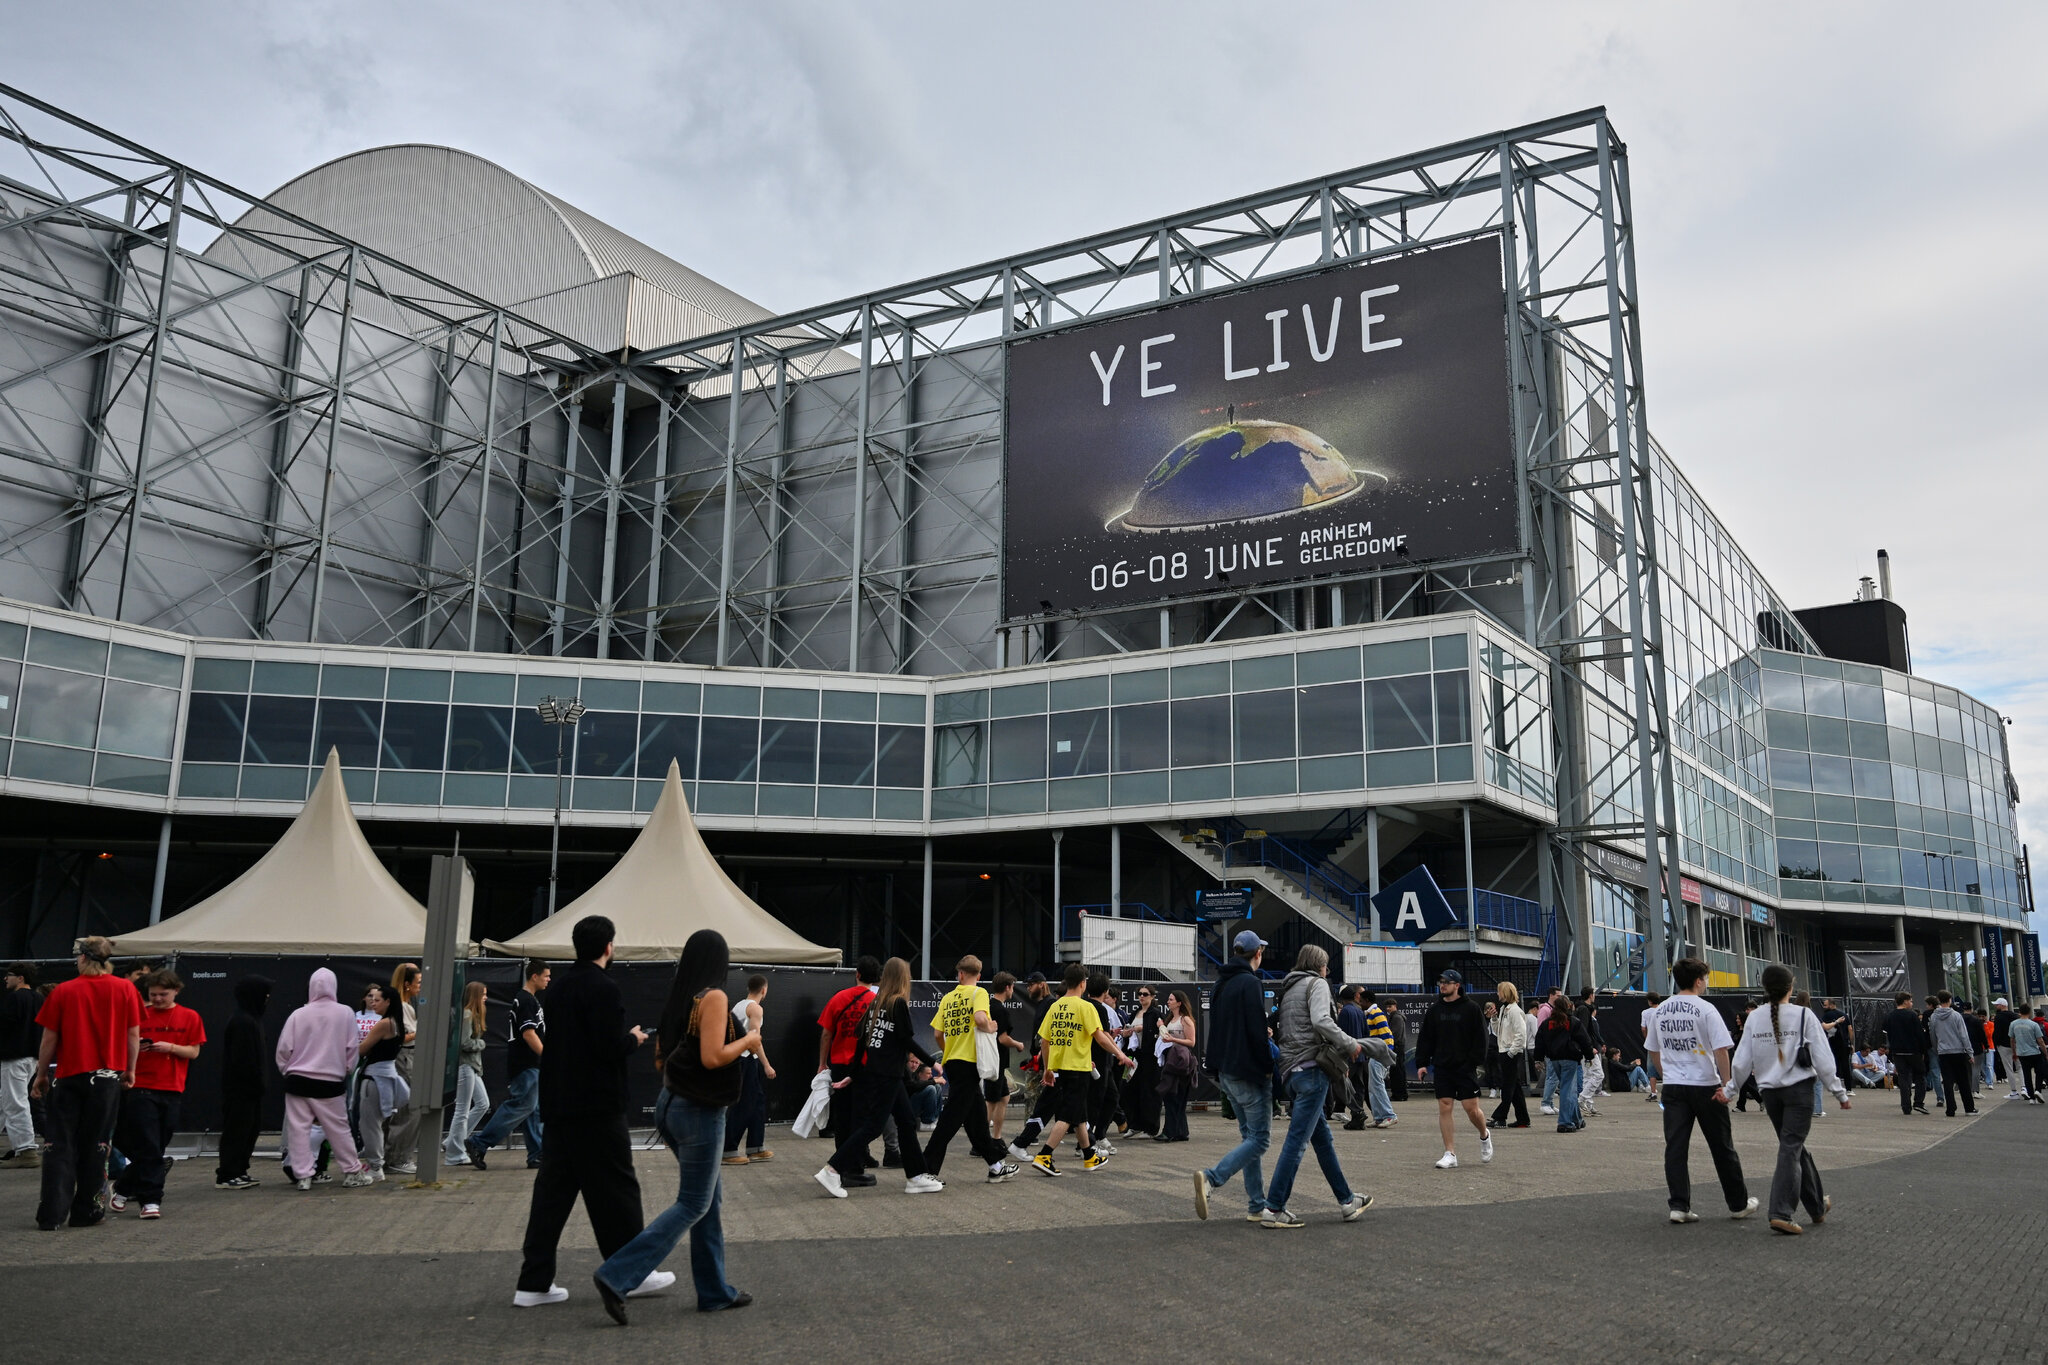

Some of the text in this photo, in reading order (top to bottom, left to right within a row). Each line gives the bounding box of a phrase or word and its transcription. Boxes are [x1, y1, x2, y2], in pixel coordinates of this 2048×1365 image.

[1090, 284, 1403, 406] YE LIVE
[1300, 521, 1372, 546] ARNHEM
[1091, 537, 1284, 592] 06-08 JUNE
[1395, 891, 1427, 930] A
[1714, 891, 1730, 911] KASSA
[1988, 932, 2000, 978] HOOFDINGANG
[2027, 939, 2038, 982] HOOFDINGANG
[192, 971, 227, 979] boels.com
[1852, 966, 1894, 978] SMOKING AREA
[959, 998, 970, 1007] AT
[1064, 1012, 1075, 1020] AT
[1660, 1019, 1694, 1033] STARRY
[1752, 1031, 1773, 1039] ASHES
